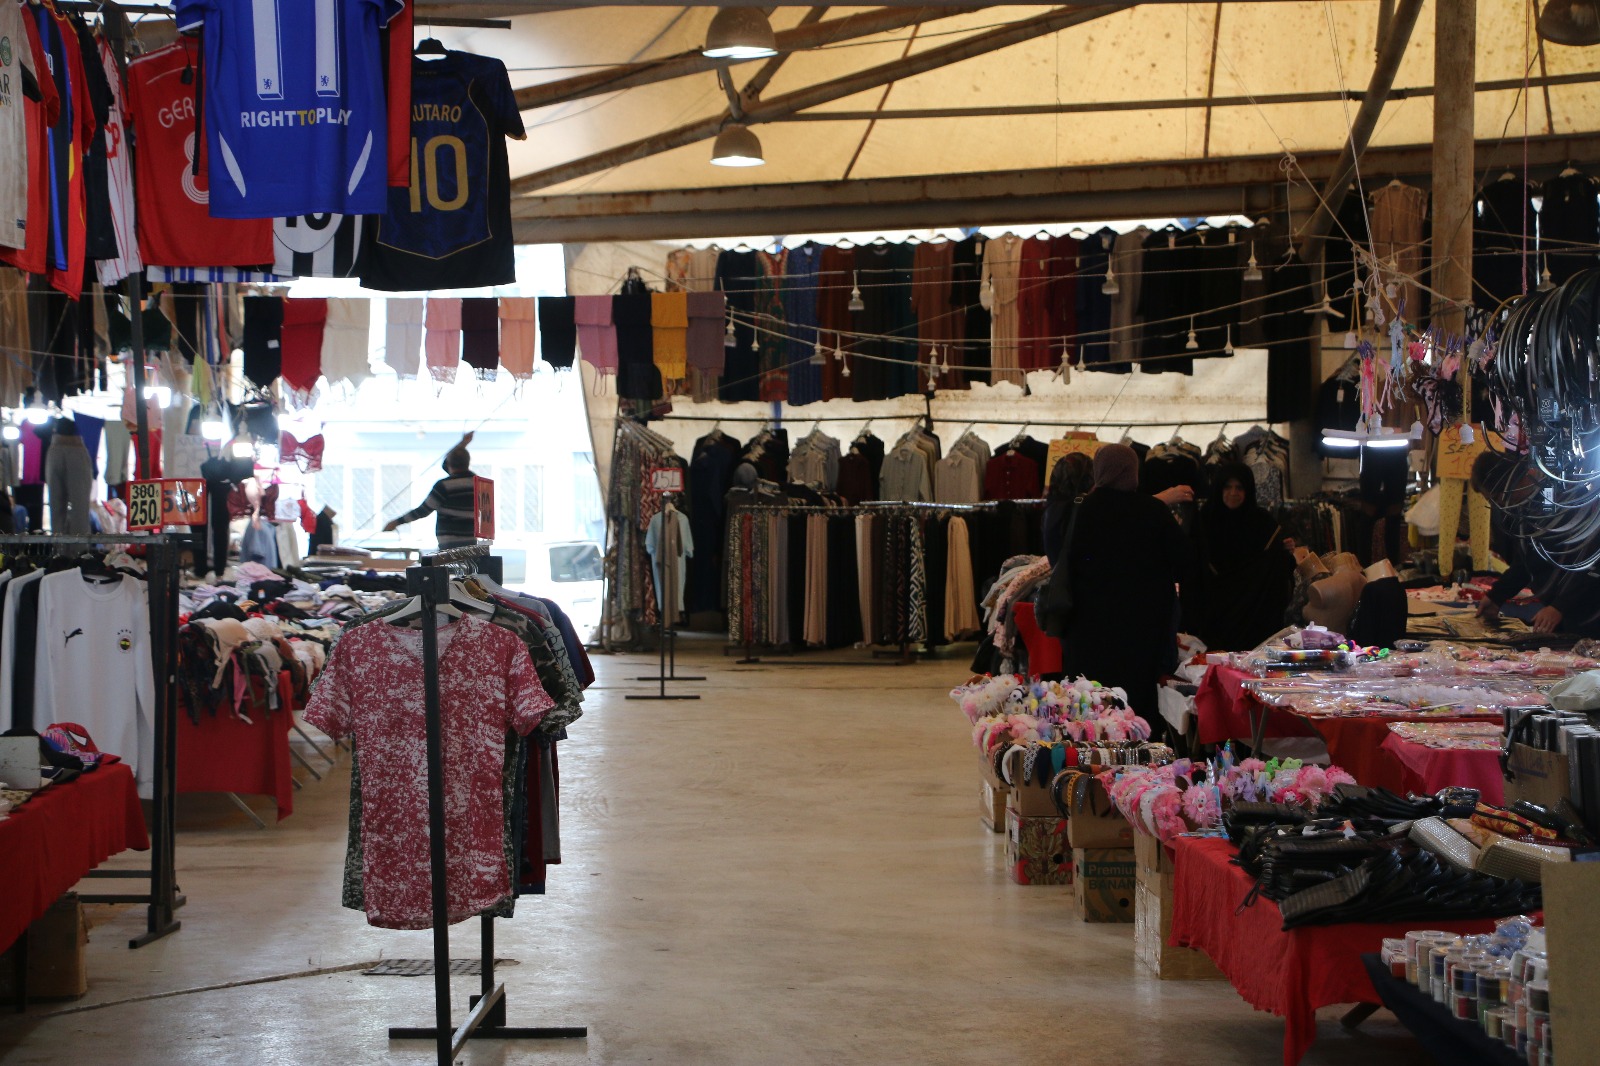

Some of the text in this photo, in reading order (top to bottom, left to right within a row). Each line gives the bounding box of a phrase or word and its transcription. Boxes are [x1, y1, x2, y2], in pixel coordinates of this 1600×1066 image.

[158, 96, 195, 128] GER
[412, 104, 462, 123] UTARO
[410, 134, 469, 213] 10
